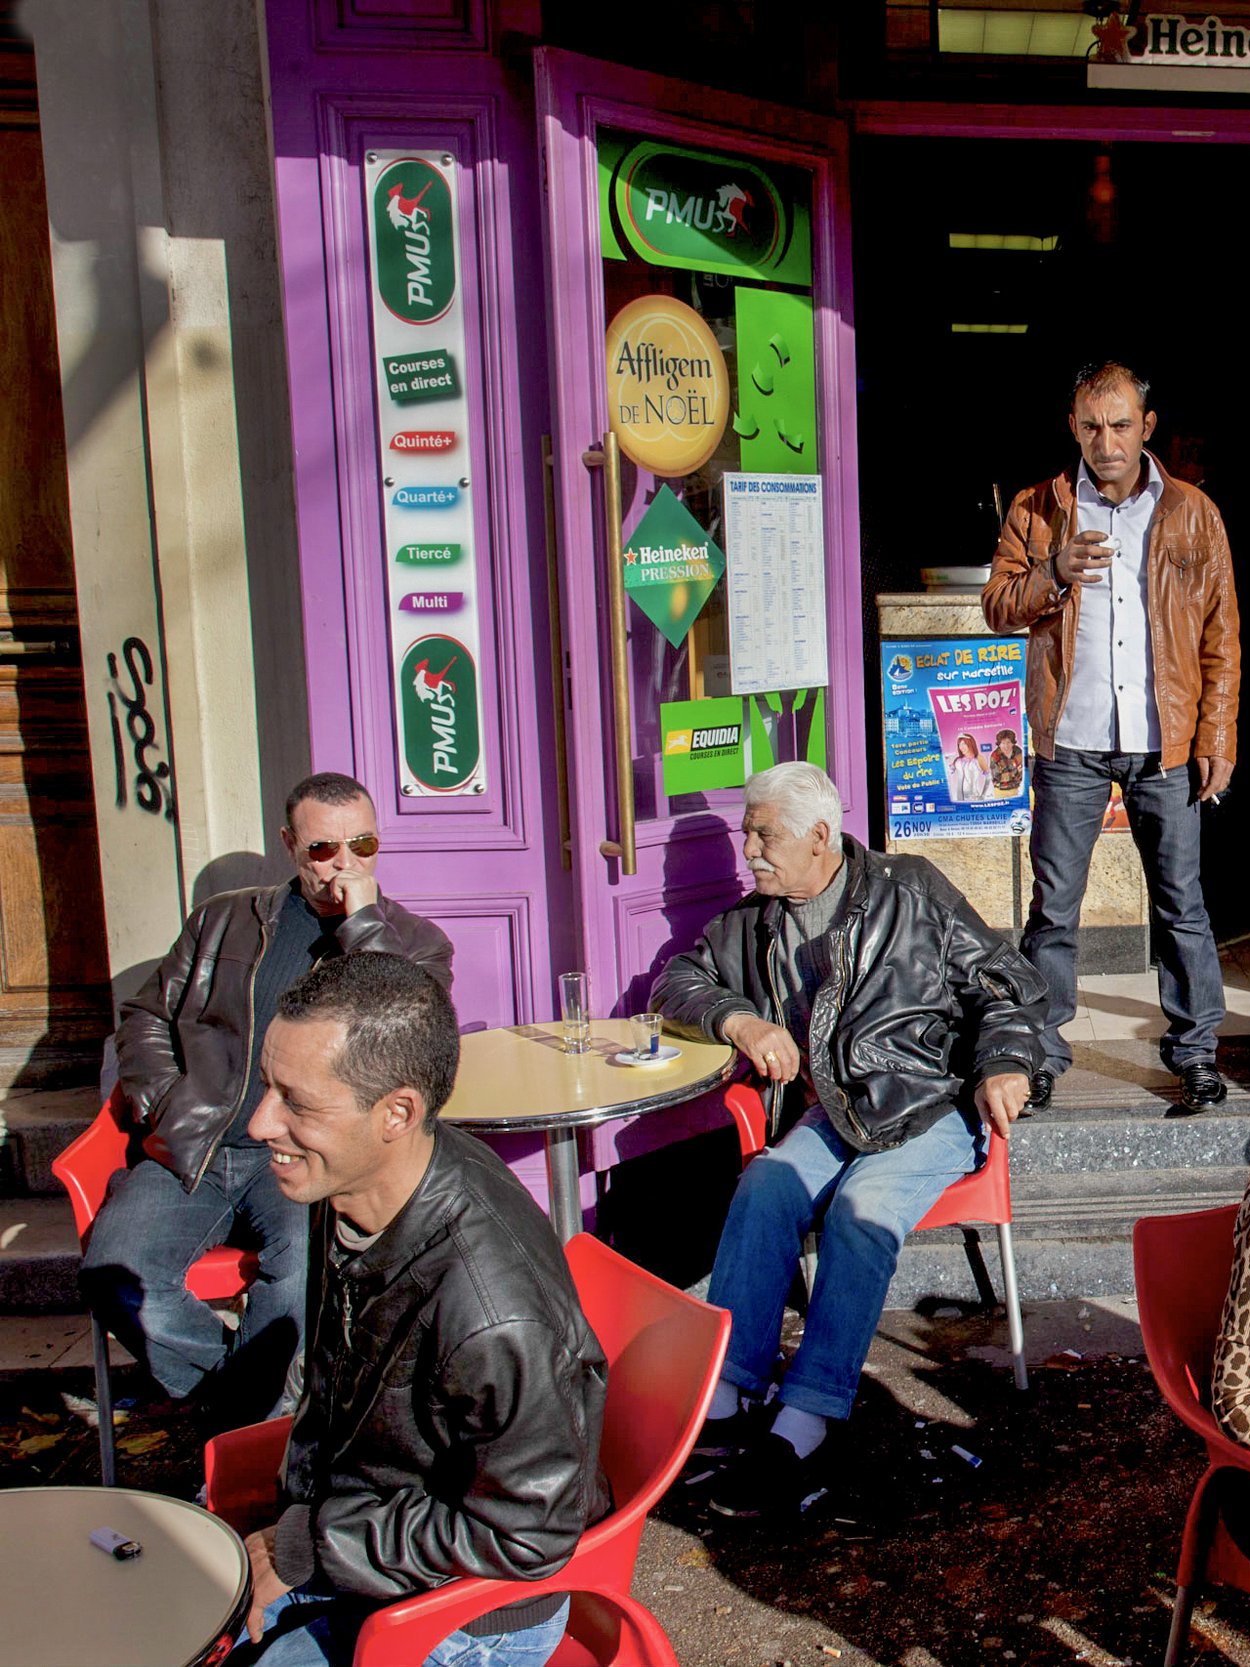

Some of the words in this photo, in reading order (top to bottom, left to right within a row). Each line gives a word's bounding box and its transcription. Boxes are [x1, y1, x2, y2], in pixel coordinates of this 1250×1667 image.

[644, 187, 716, 232] PMU
[404, 231, 435, 307] PMU
[388, 357, 446, 376] Courses
[615, 340, 713, 391] Affligem
[390, 380, 409, 394] en
[410, 372, 453, 391] direct
[619, 404, 641, 425] DE
[643, 389, 715, 426] NOËL
[393, 434, 453, 451] Quinté+
[396, 490, 456, 504] Quarté+
[730, 481, 747, 493] TARIF
[748, 481, 760, 493] DES
[761, 482, 817, 494] CONSOMMATIONS
[406, 547, 452, 560] Tiercé
[639, 545, 710, 565] Heineken
[640, 563, 711, 582] PRESSION
[412, 596, 448, 608] Multi
[915, 652, 950, 669] ECLAT
[954, 648, 973, 666] DE
[978, 643, 1023, 662] RIRE
[936, 671, 960, 681] sur
[962, 665, 1014, 680] Marseille
[936, 693, 972, 713] LES
[974, 687, 1018, 711] POZ'
[430, 702, 459, 774] PMU
[692, 726, 739, 748] EQUIDIA
[689, 749, 714, 760] COURSES
[713, 749, 722, 758] EN
[722, 747, 740, 757] DIRECT
[912, 820, 932, 833] NOV
[986, 813, 1008, 821] LAVIE
[894, 820, 912, 838] 26
